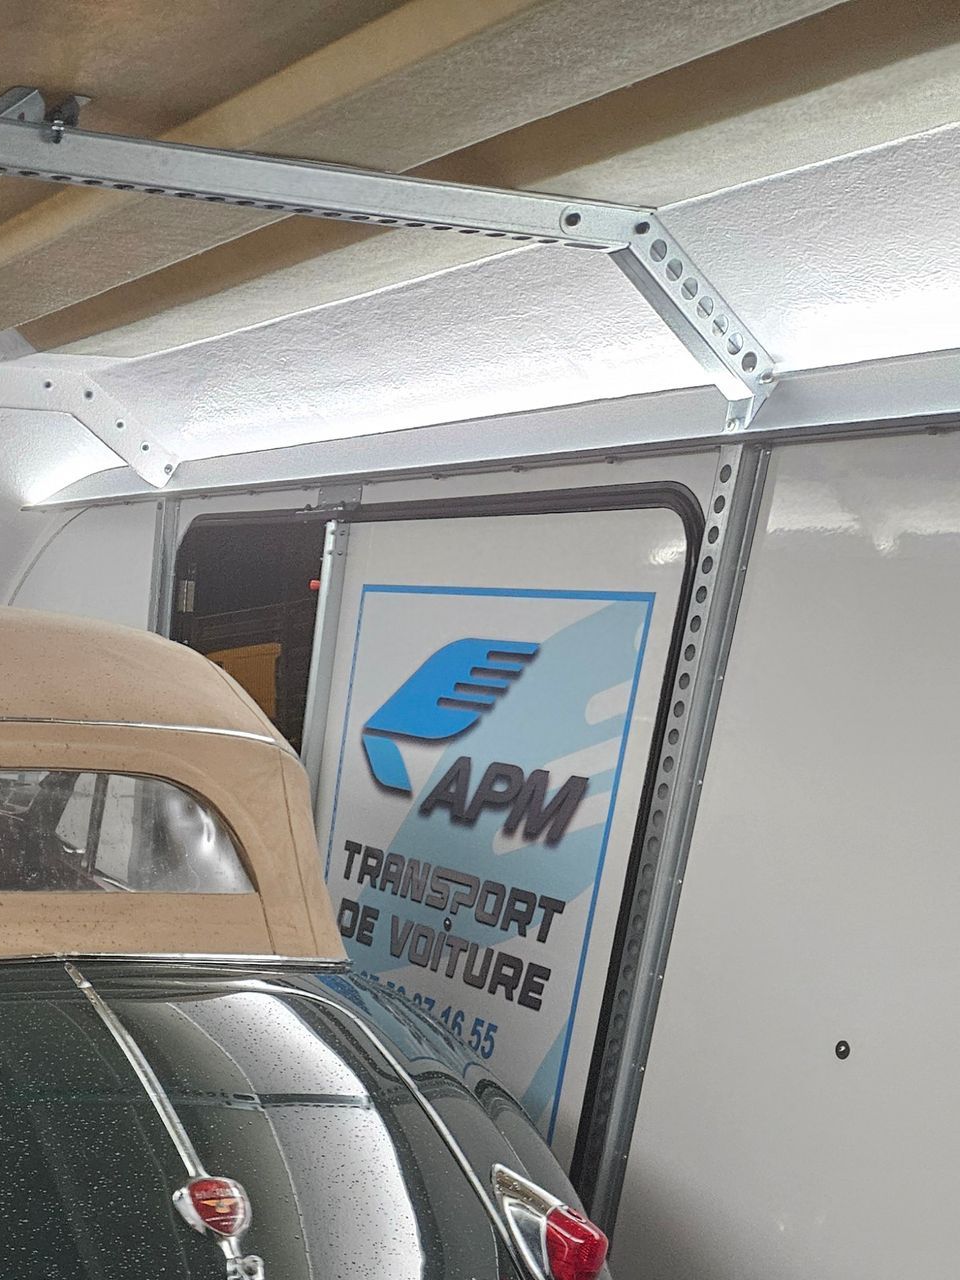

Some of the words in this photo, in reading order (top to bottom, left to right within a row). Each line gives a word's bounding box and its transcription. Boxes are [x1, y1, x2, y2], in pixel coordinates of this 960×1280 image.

[418, 756, 589, 847] APM
[343, 840, 566, 943] TRANSPORT
[338, 898, 380, 946] DE
[390, 914, 552, 1012] VOITURE
